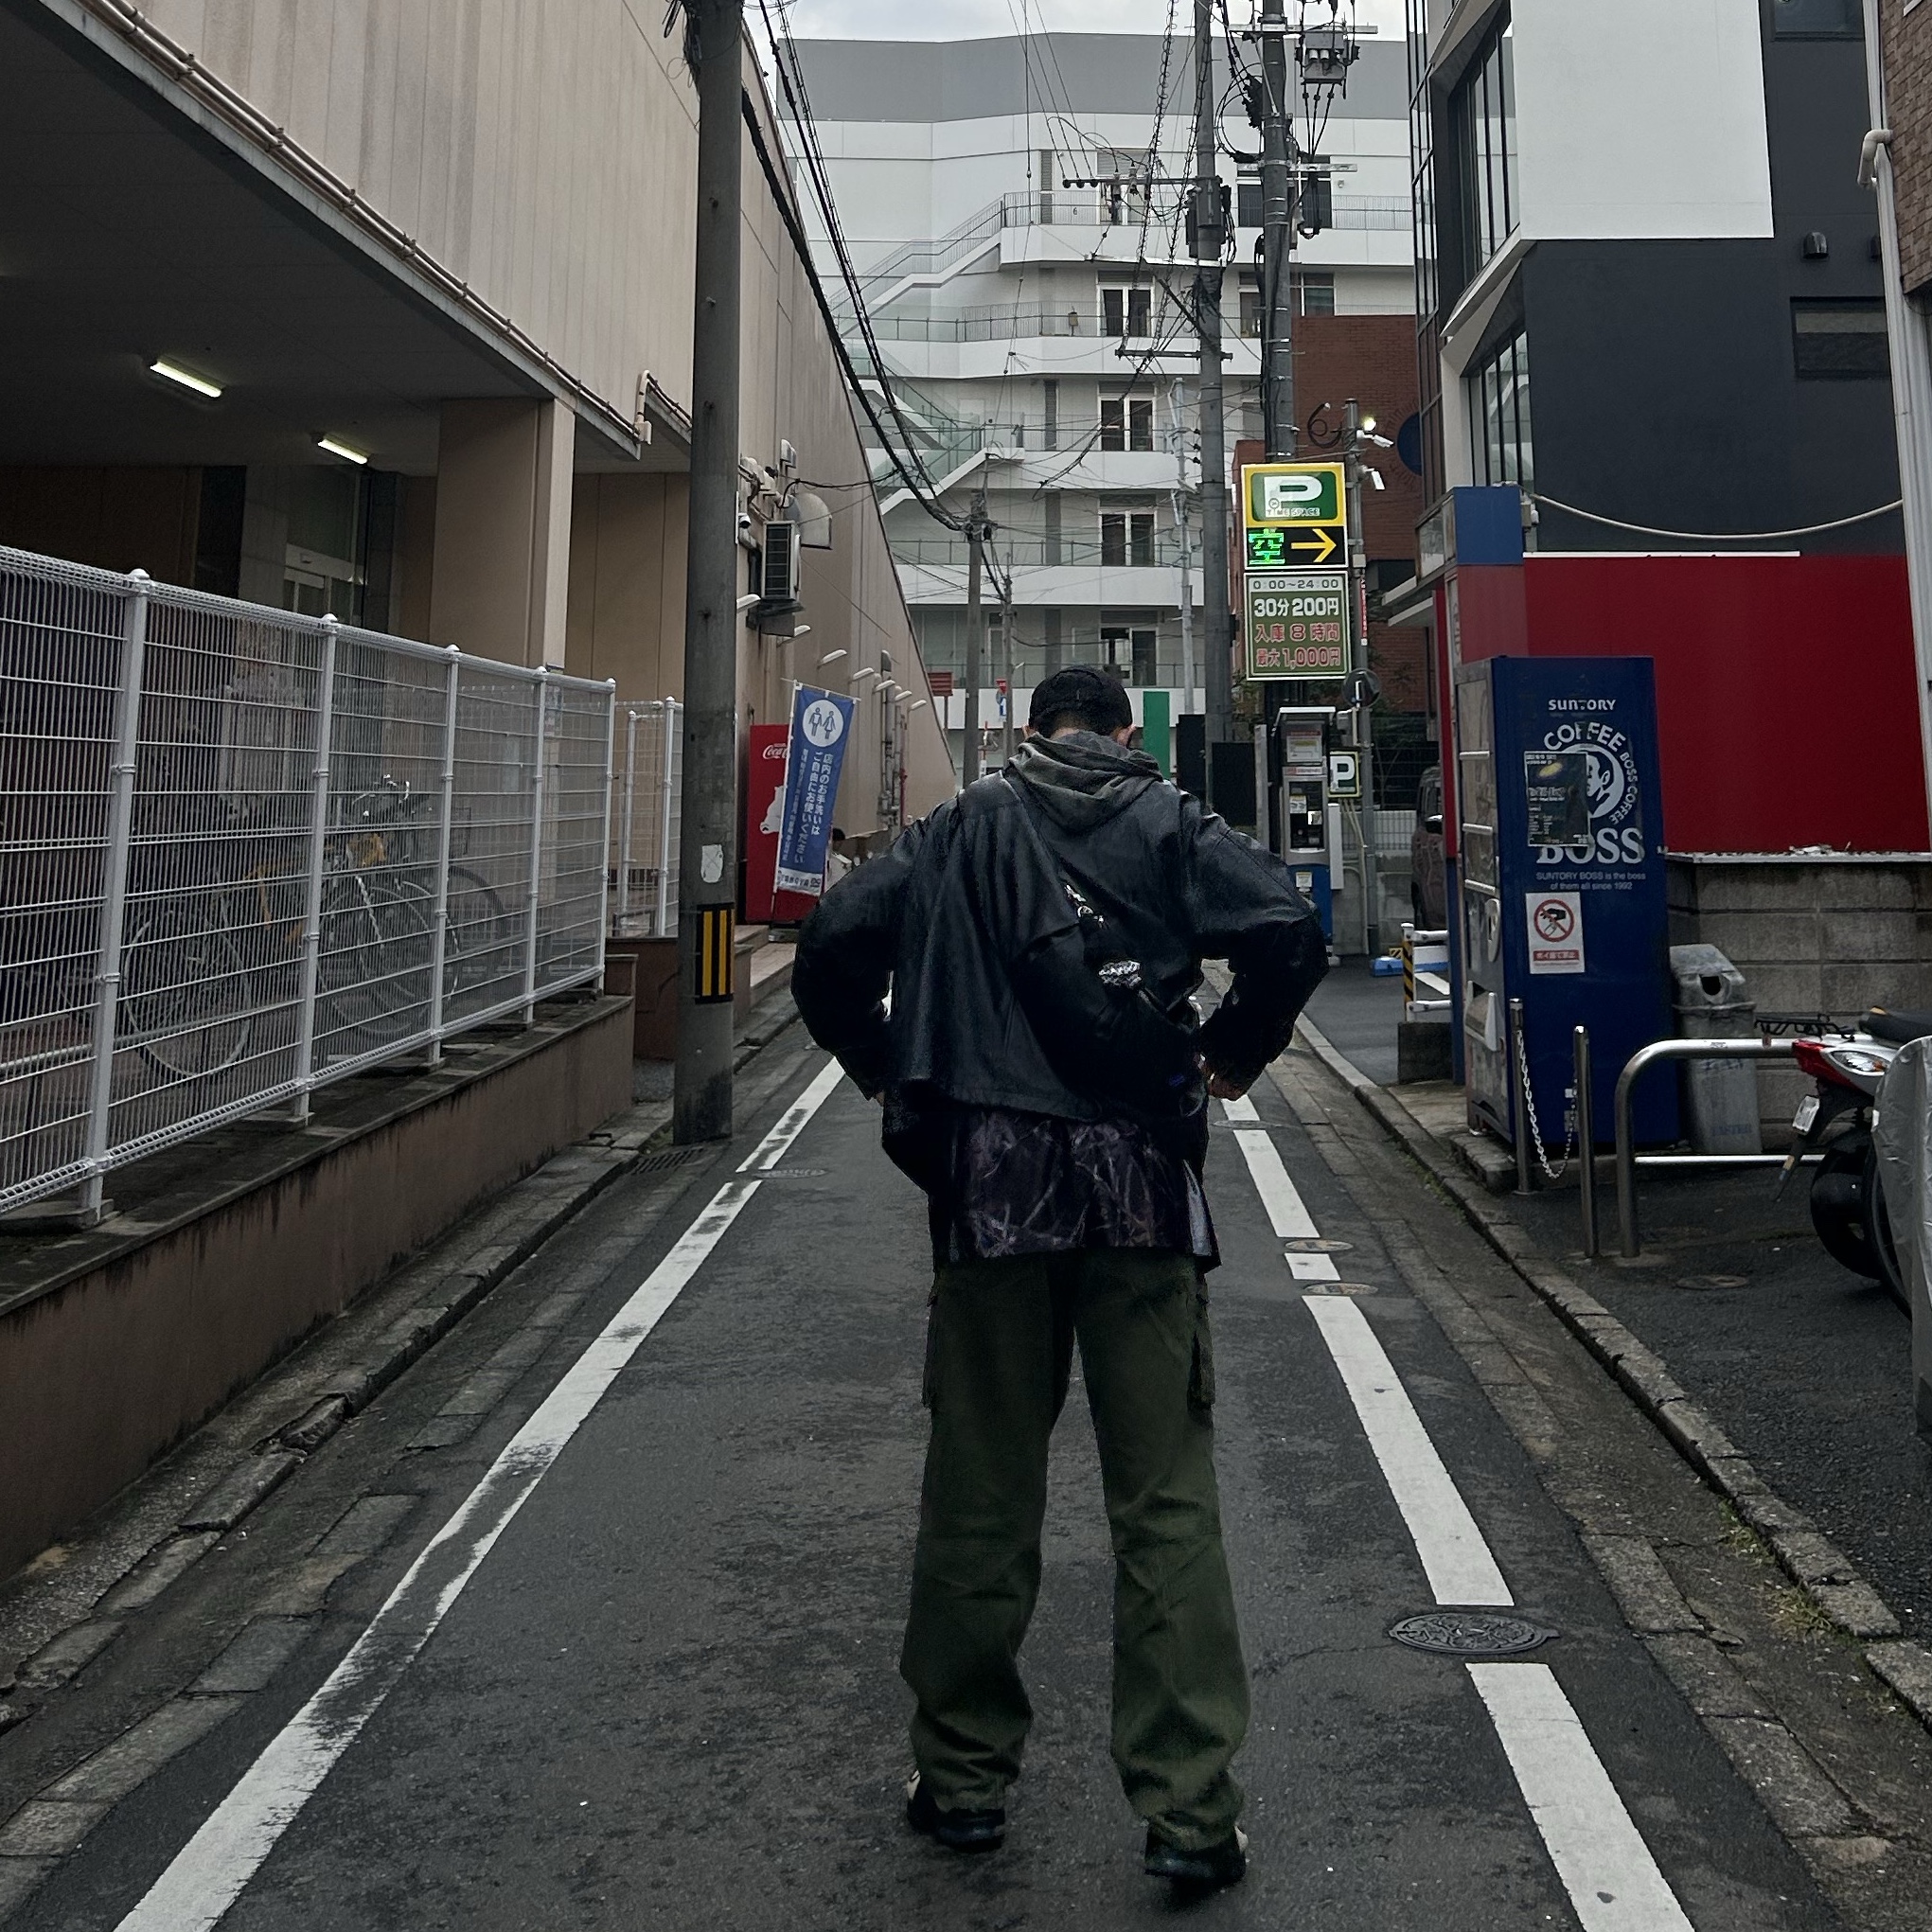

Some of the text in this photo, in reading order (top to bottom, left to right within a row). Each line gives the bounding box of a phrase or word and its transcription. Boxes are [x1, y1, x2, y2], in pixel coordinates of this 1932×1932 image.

[1264, 475, 1322, 518] P
[1290, 507, 1320, 516] SPACE
[1248, 528, 1285, 565] 空
[1329, 755, 1356, 792] P
[1535, 872, 1578, 880] SUNTORY
